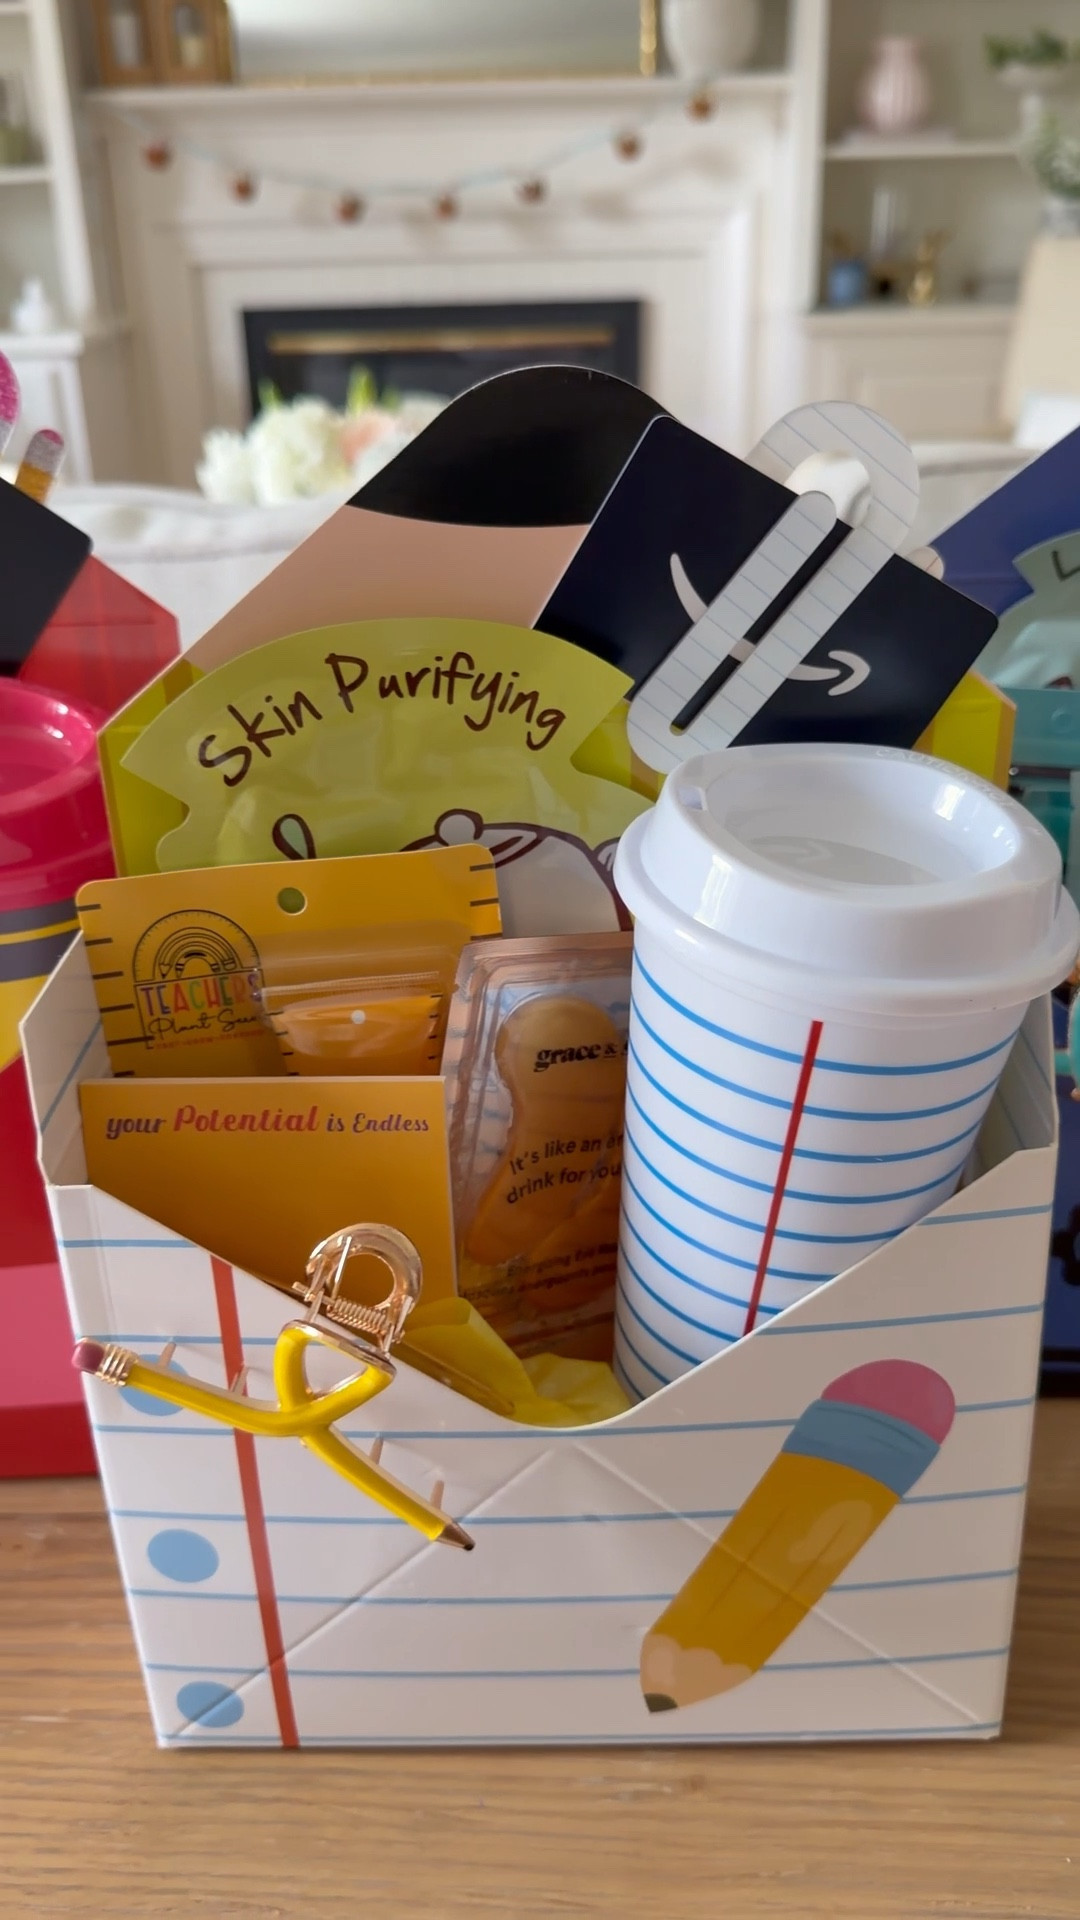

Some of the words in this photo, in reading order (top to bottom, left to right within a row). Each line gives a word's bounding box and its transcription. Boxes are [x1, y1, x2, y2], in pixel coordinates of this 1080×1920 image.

[198, 691, 323, 787] Skin
[325, 651, 567, 751] Purifying
[140, 973, 262, 1017] TEACHERS
[148, 1012, 217, 1040] Plant
[533, 1043, 601, 1073] grace
[604, 1042, 618, 1059] &
[106, 1116, 166, 1140] your
[173, 1104, 319, 1133] Potential
[326, 1112, 345, 1134] is
[352, 1112, 430, 1134] Endless
[509, 1150, 540, 1176] It's
[544, 1139, 577, 1159] like
[580, 1137, 602, 1153] an
[506, 1171, 555, 1204] drink
[559, 1167, 587, 1185] for
